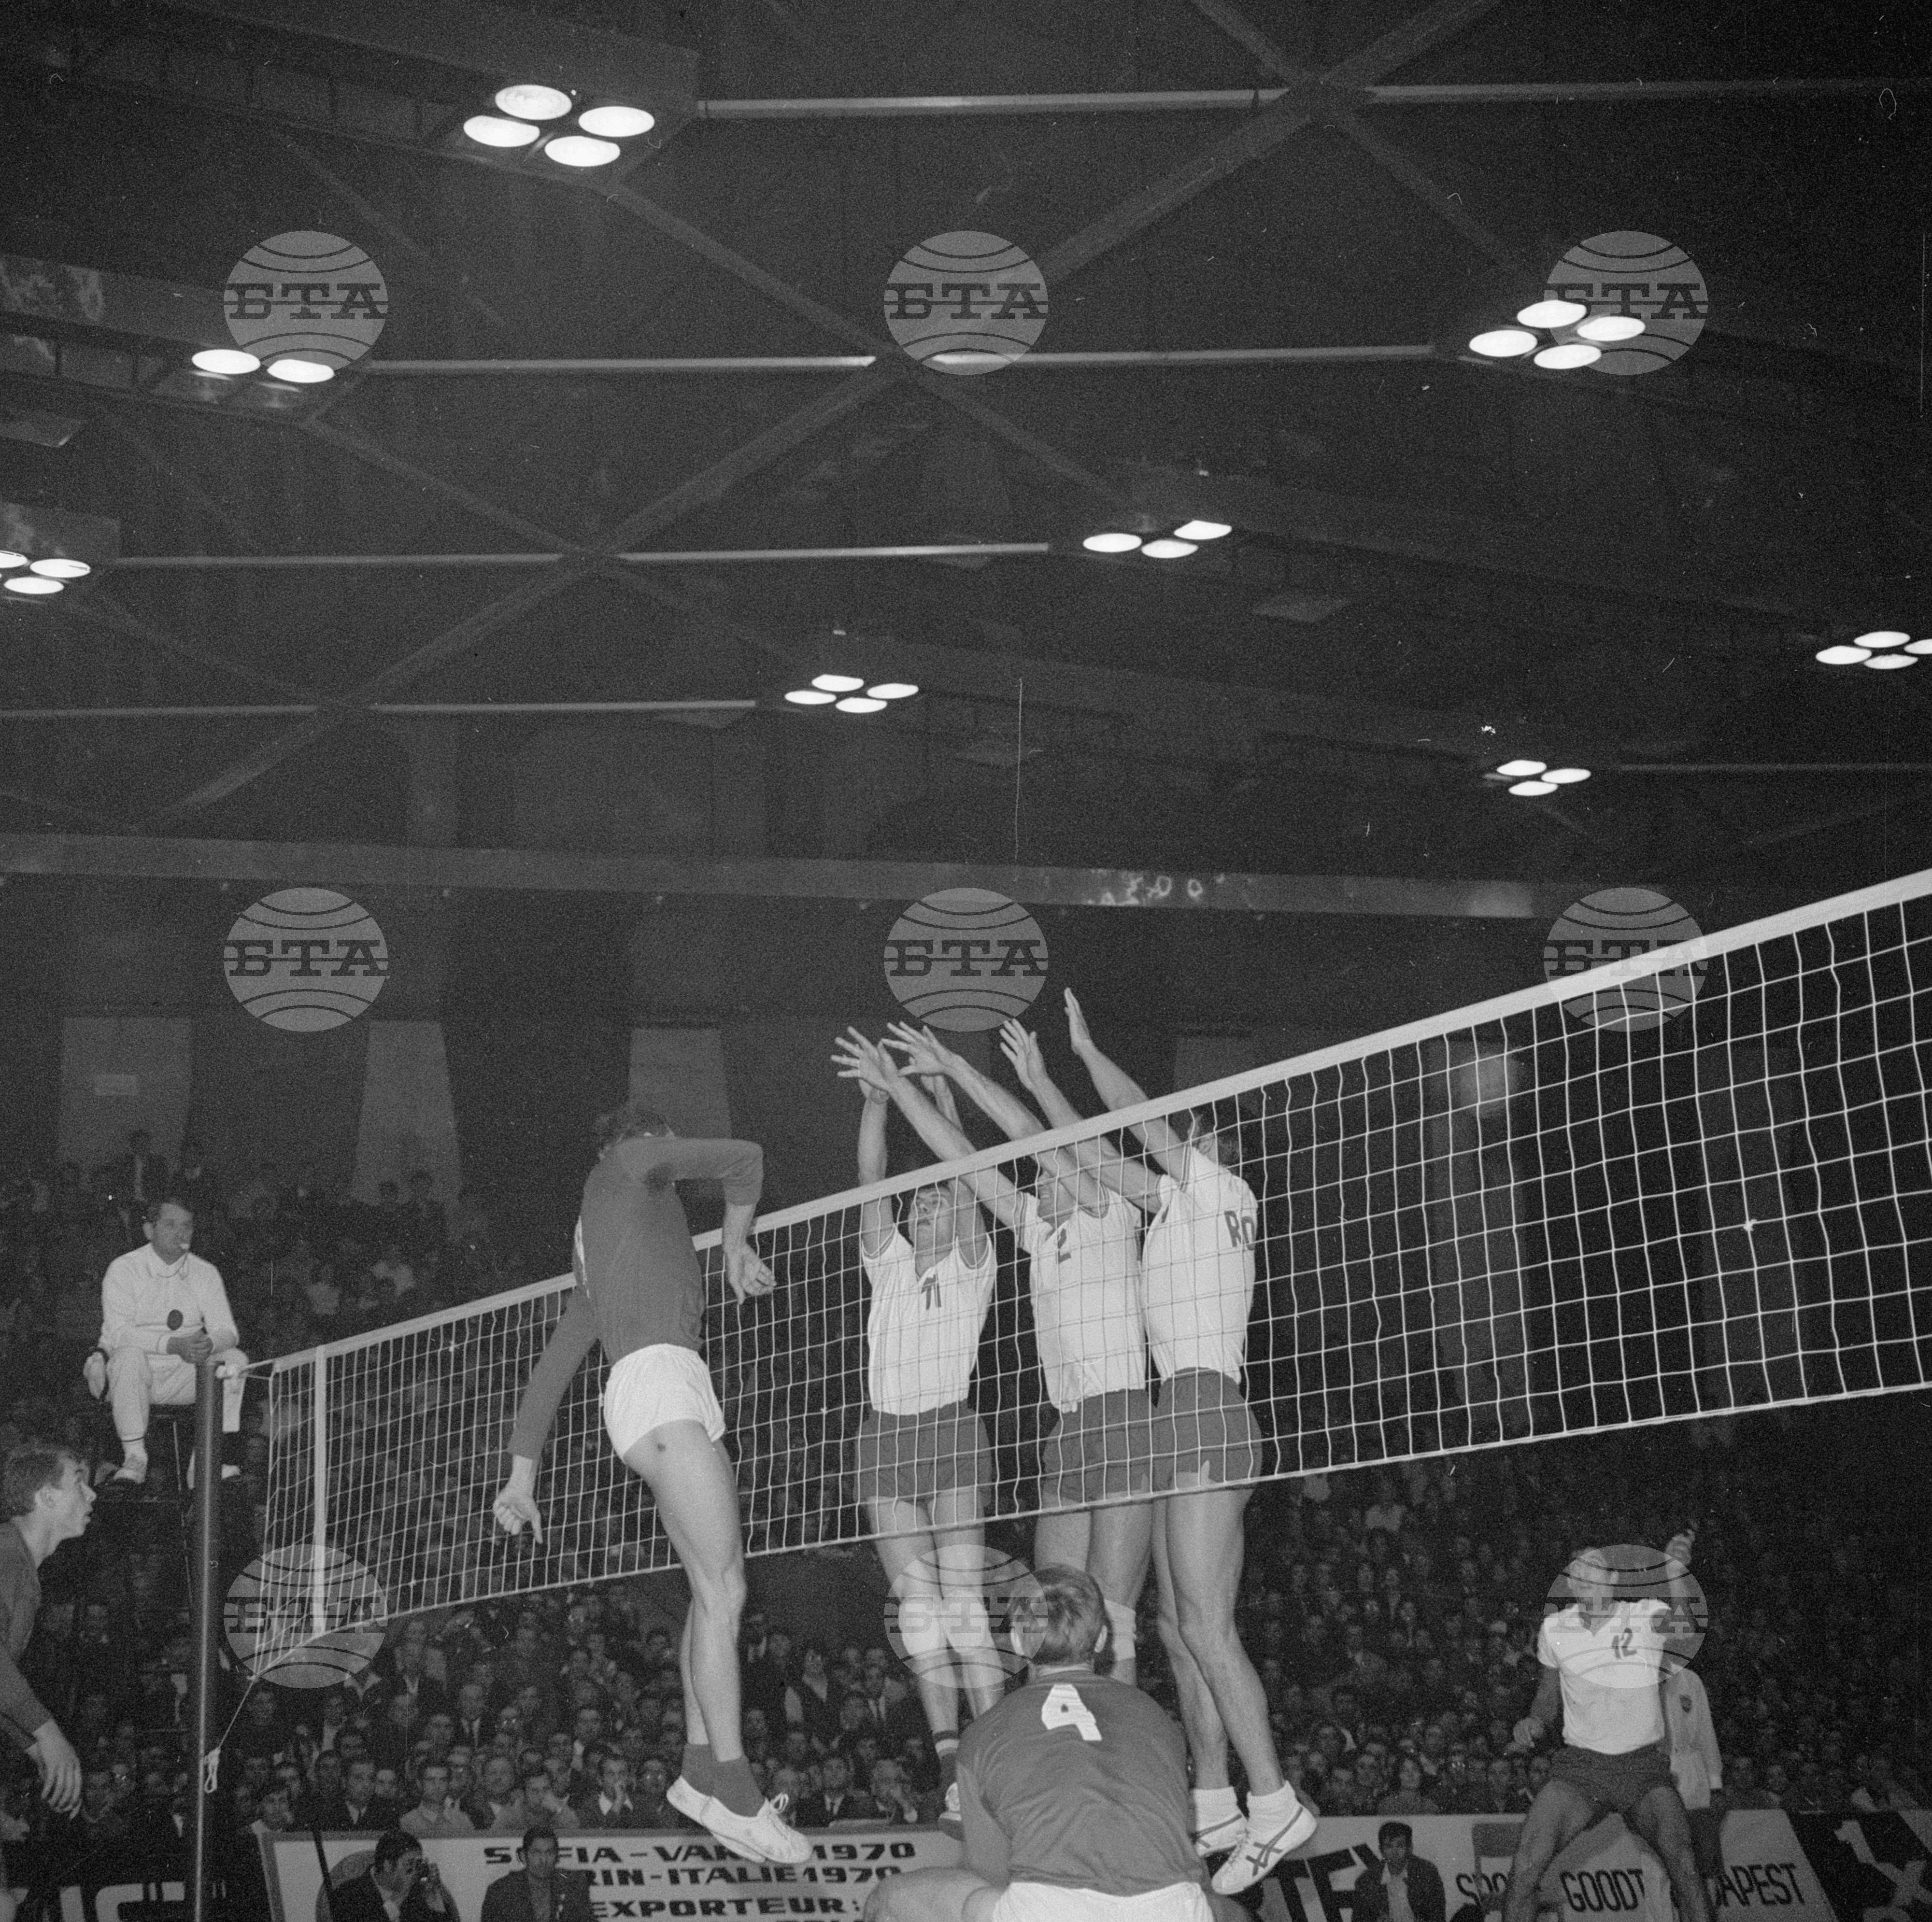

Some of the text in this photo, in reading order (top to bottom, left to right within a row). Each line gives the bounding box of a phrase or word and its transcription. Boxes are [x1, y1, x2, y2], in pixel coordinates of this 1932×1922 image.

[1612, 1627, 1638, 1660] 12
[1041, 1683, 1103, 1741] 4
[812, 1842, 916, 1861] 1970
